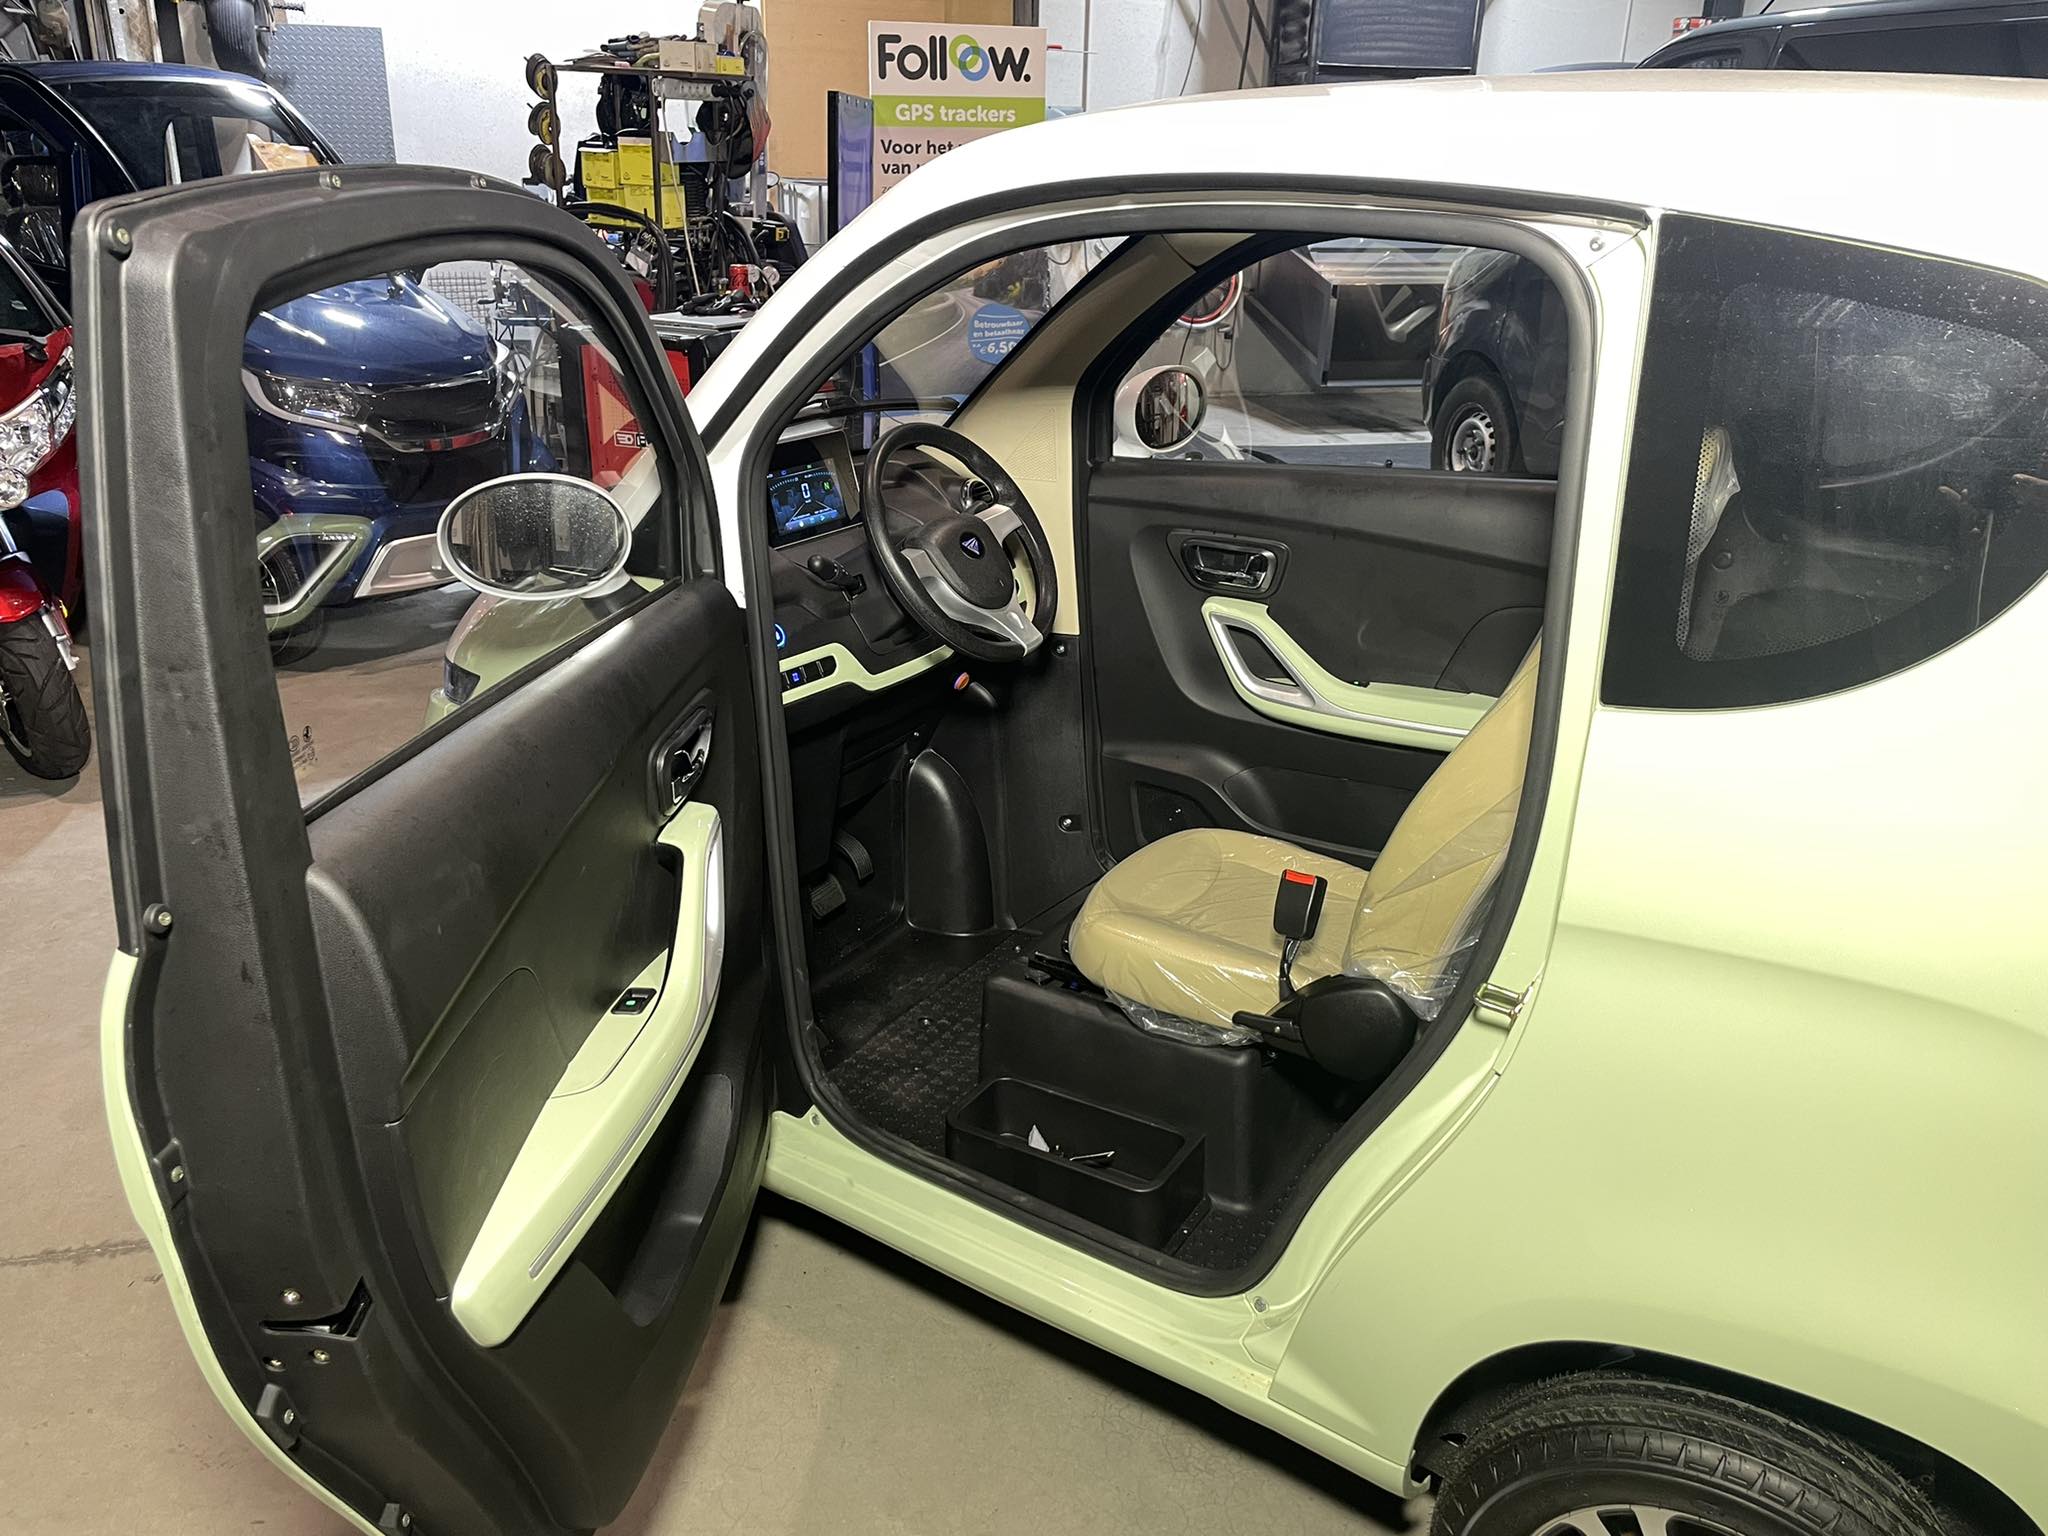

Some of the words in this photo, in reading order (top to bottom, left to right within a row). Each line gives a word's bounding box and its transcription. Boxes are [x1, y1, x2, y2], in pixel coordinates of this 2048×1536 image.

[877, 33, 1031, 82] Follow.
[895, 104, 934, 122] GPS
[940, 104, 1016, 123] trackers
[880, 139, 922, 155] Voor
[926, 140, 954, 155] het
[881, 163, 911, 175] van
[801, 483, 810, 499] 0
